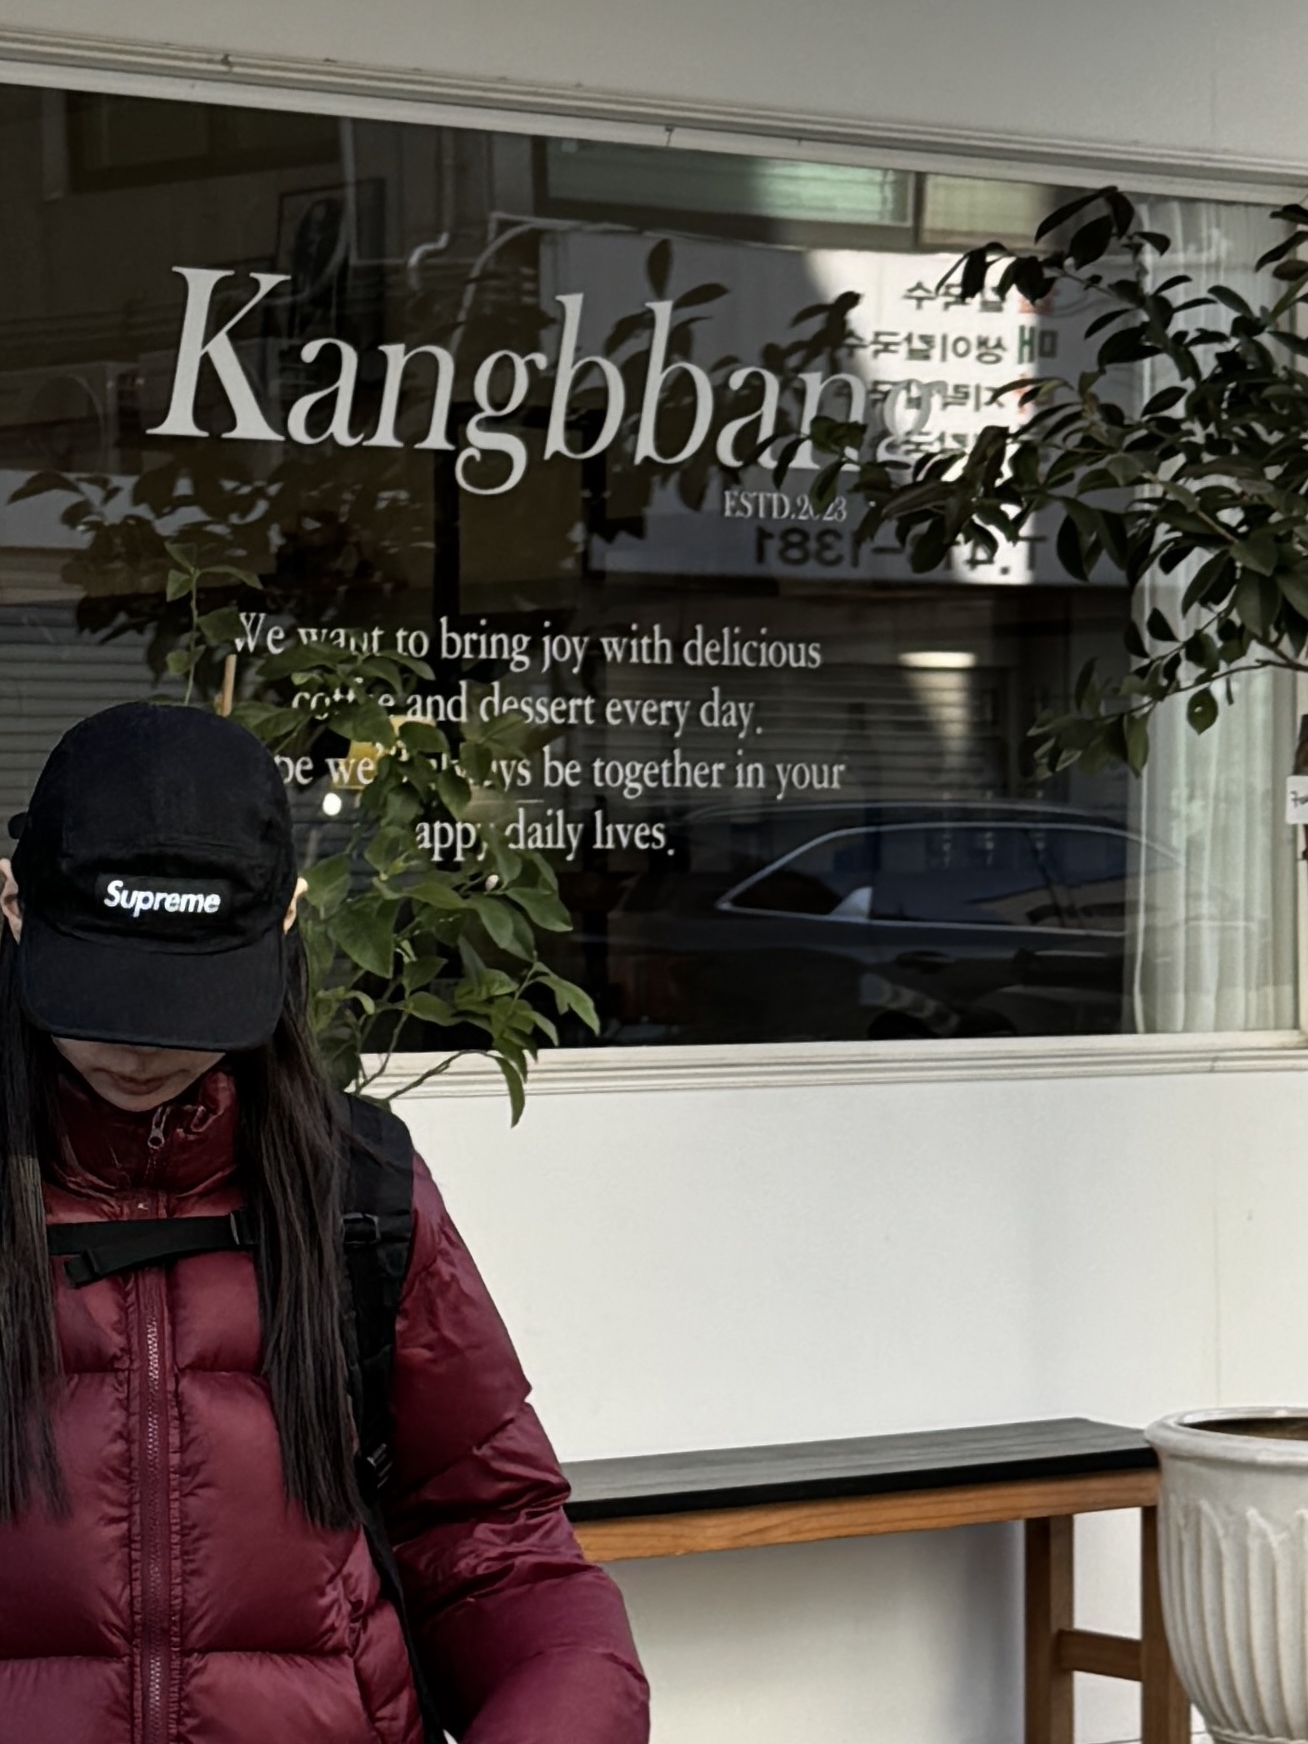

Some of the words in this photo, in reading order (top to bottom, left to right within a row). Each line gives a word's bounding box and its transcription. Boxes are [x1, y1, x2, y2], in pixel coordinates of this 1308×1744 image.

[235, 612, 285, 654] We
[396, 629, 430, 658] to
[440, 615, 531, 672] bring
[541, 621, 590, 674] joy
[600, 623, 675, 667] with
[682, 624, 823, 669] delicious
[406, 680, 468, 723] and
[479, 681, 596, 727] dessert
[605, 698, 692, 738] every
[699, 685, 764, 738] day.
[543, 744, 582, 789] be
[593, 748, 725, 799] together
[735, 748, 765, 789] in
[776, 758, 846, 801] your
[505, 806, 585, 862] daily
[103, 879, 222, 918] Supreme
